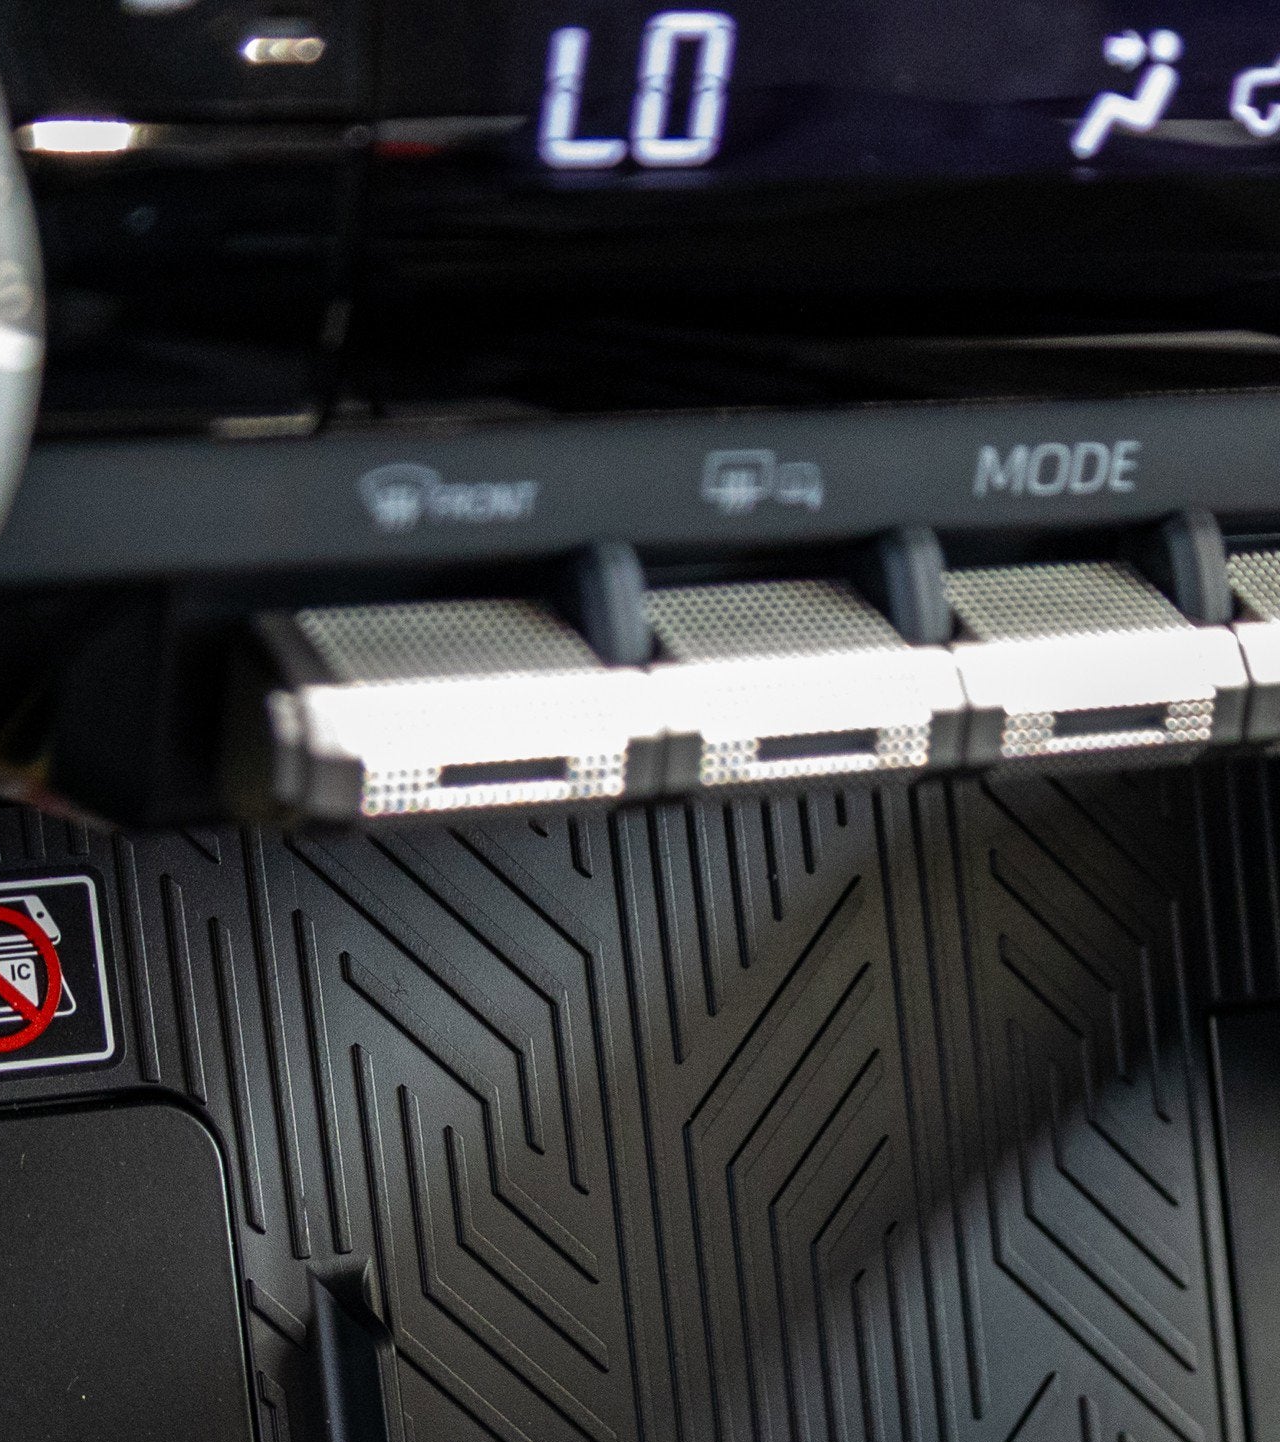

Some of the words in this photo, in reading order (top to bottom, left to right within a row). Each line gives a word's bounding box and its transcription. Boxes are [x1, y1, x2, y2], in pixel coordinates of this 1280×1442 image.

[538, 11, 736, 168] LO
[973, 440, 1142, 497] MODE
[428, 480, 539, 520] FRONT
[10, 962, 32, 982] IC
